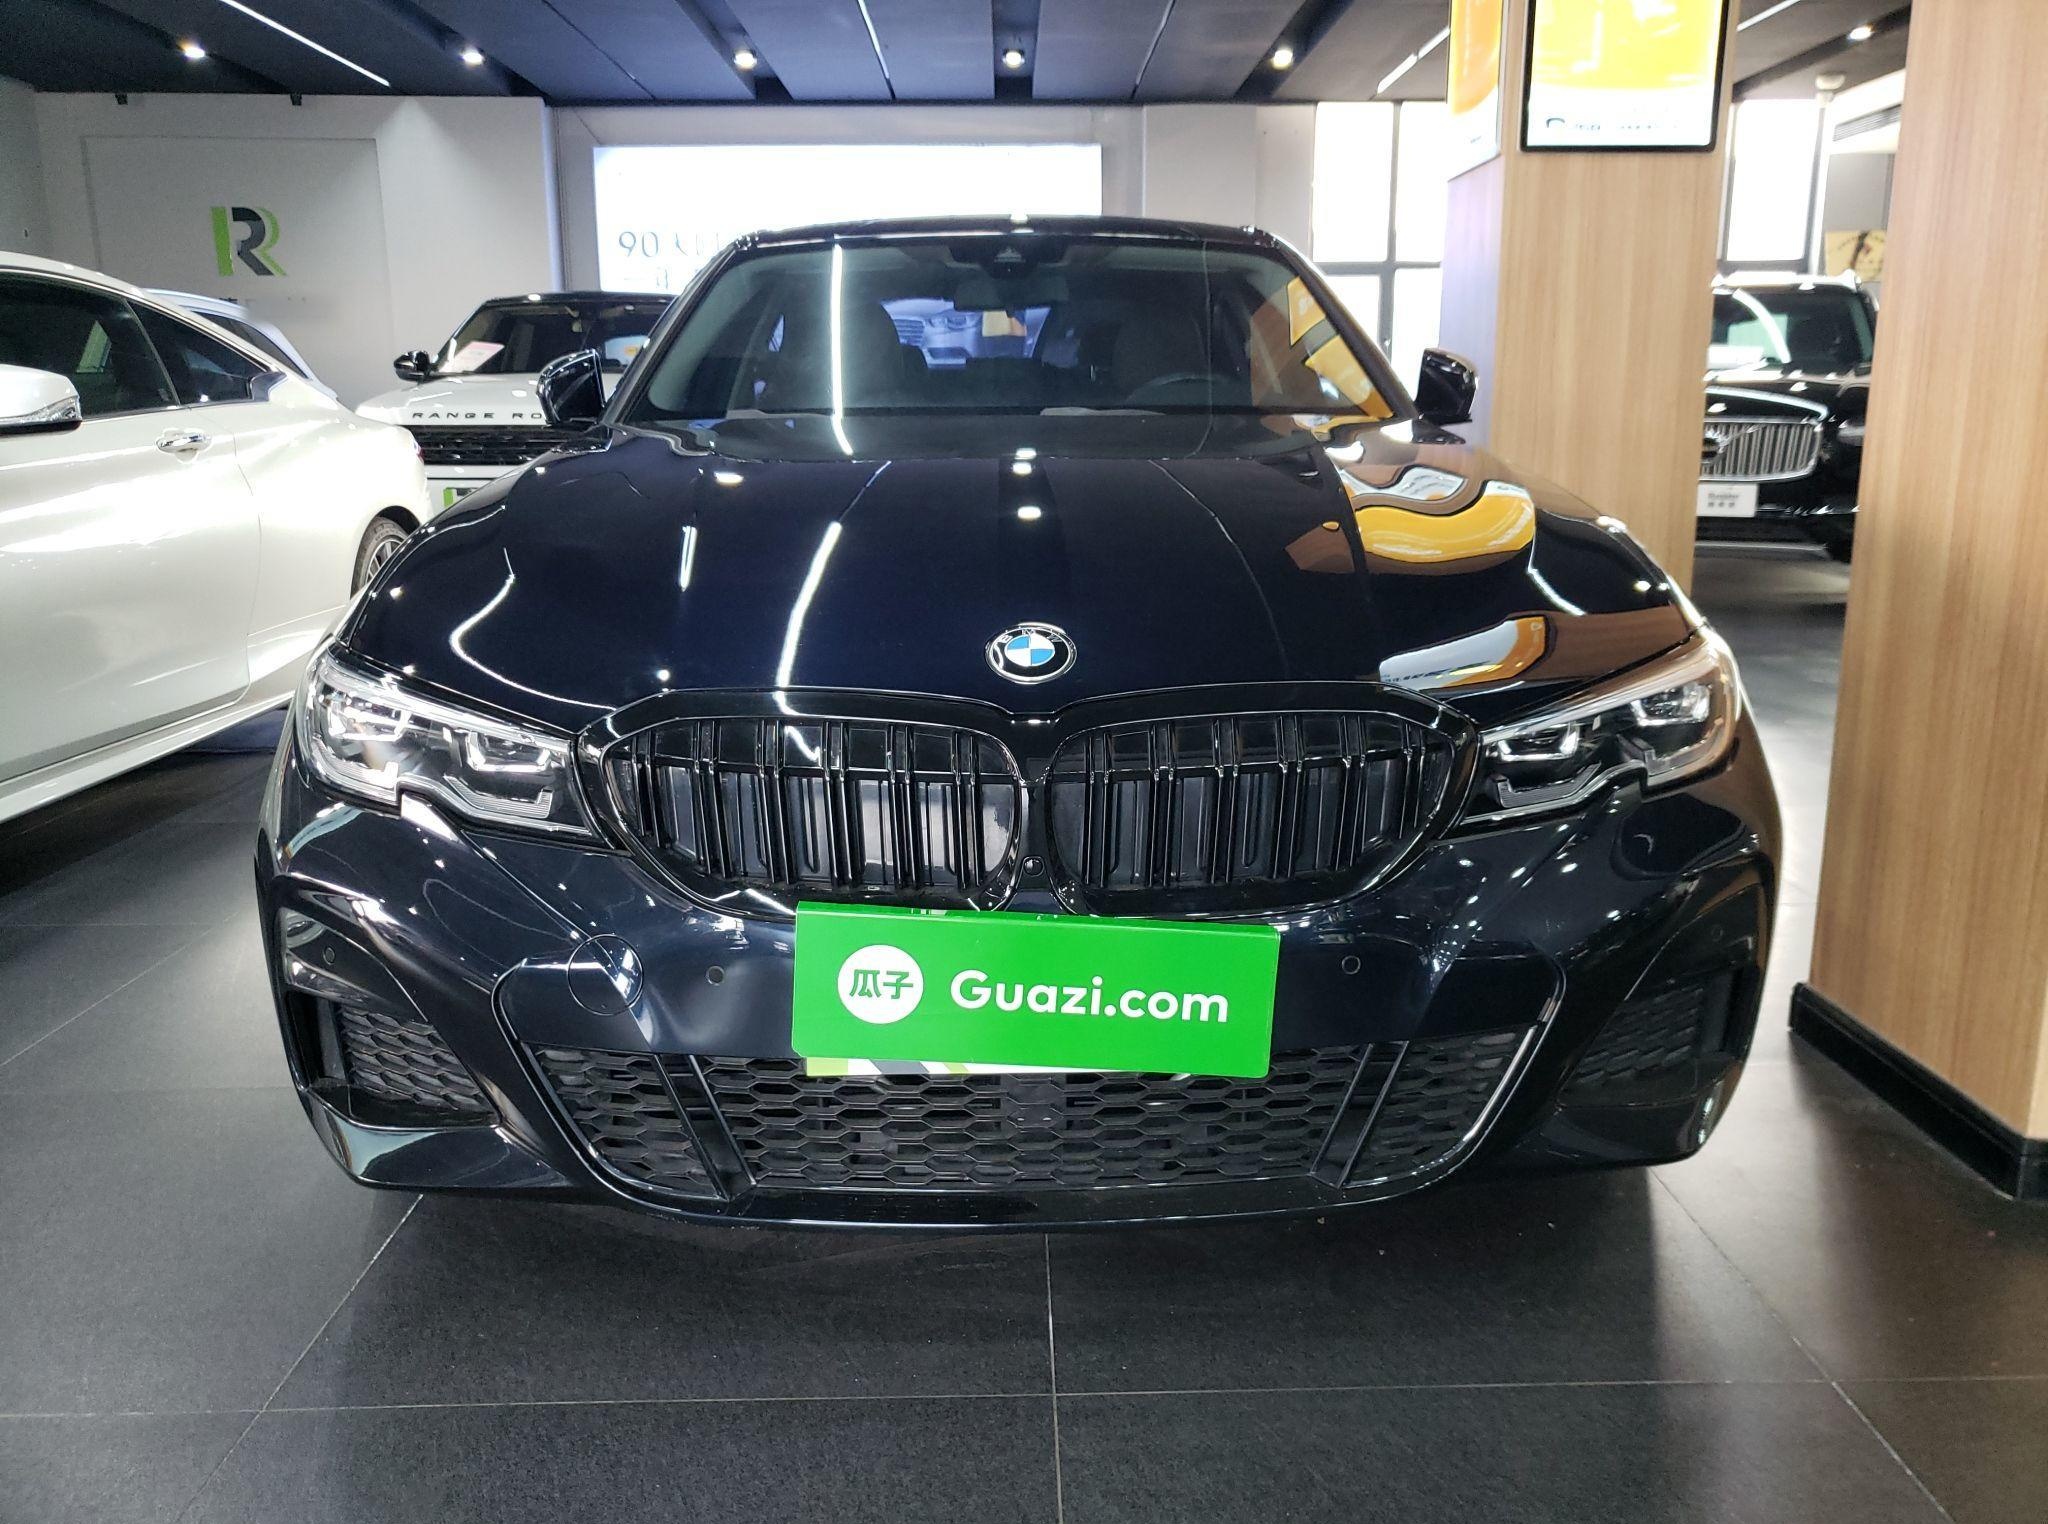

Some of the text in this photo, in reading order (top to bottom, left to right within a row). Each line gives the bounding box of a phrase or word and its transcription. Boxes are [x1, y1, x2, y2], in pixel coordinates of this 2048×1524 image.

[412, 411, 543, 420] RANGE RO
[849, 968, 914, 1000] 瓜子
[950, 968, 1229, 1024] Guazi.com
